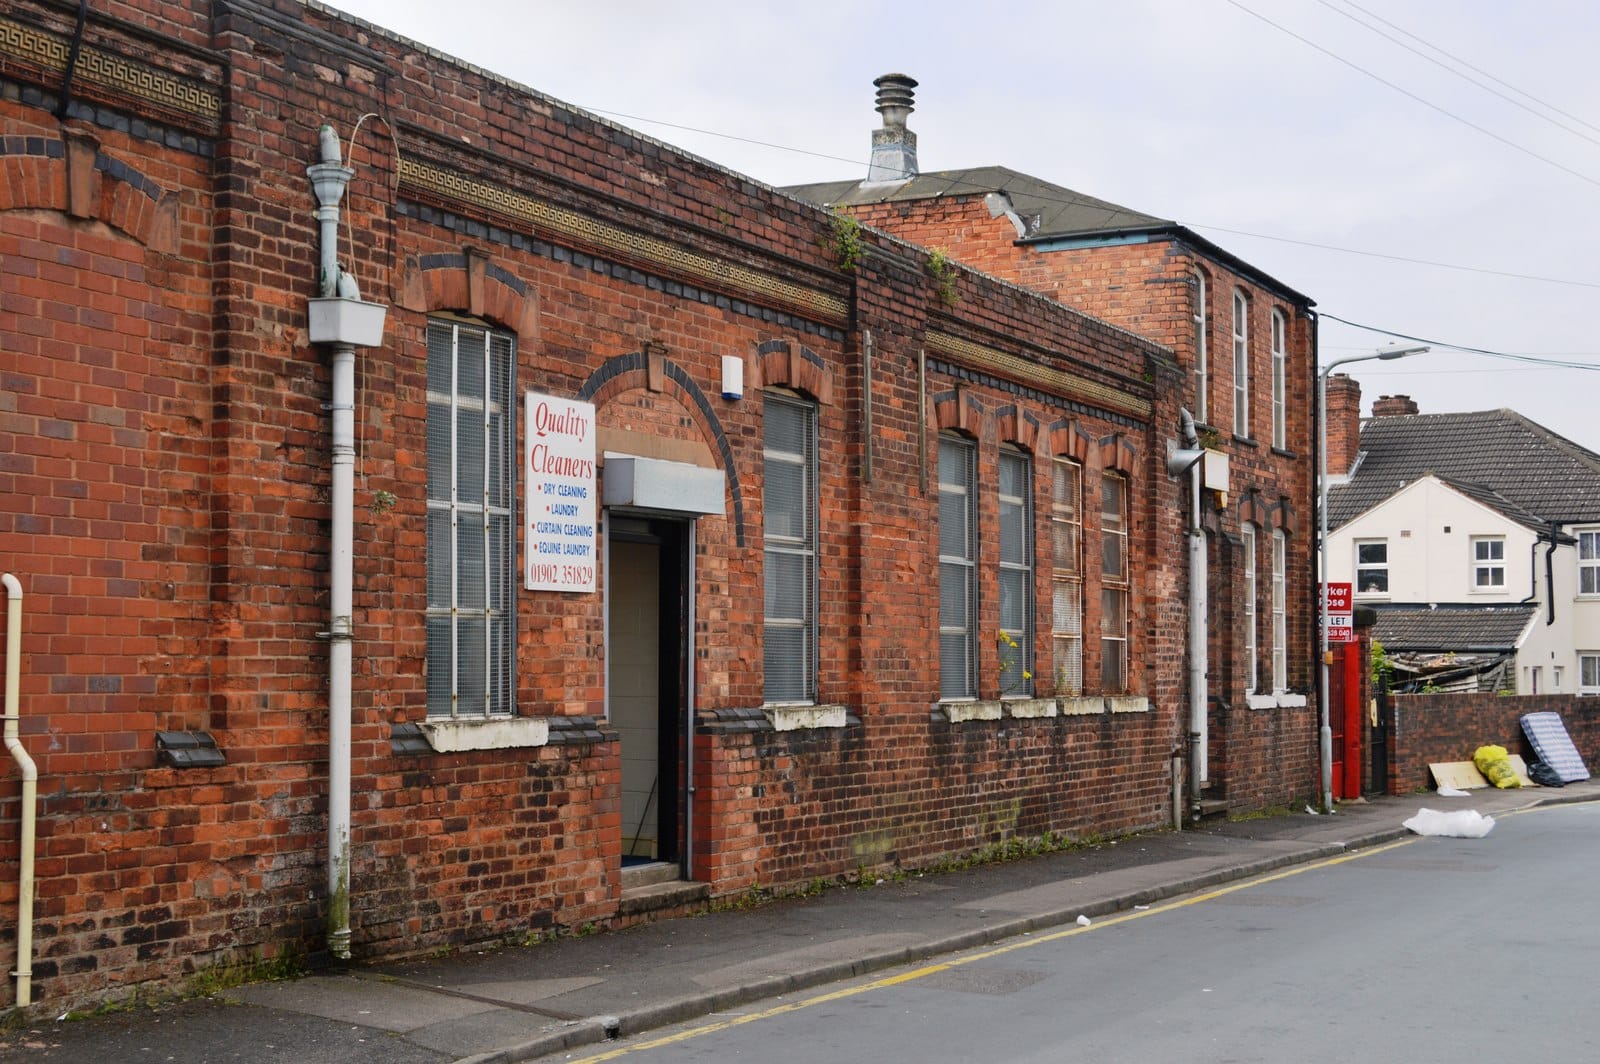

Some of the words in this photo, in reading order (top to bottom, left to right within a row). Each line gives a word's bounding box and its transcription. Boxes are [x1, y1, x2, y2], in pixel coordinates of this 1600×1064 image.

[536, 402, 587, 443] Quality
[531, 444, 592, 479] Cleaners
[544, 483, 556, 495] DRY
[558, 484, 587, 499] CLEANING
[551, 504, 579, 517] LAUNDRY
[537, 521, 562, 535] CURTAIN
[564, 524, 593, 538] CLEANING
[539, 542, 561, 555] EQUINE
[563, 544, 591, 556] LAUNDRY
[531, 563, 557, 583] 01902
[562, 565, 593, 585] 351829
[1331, 617, 1346, 625] LET
